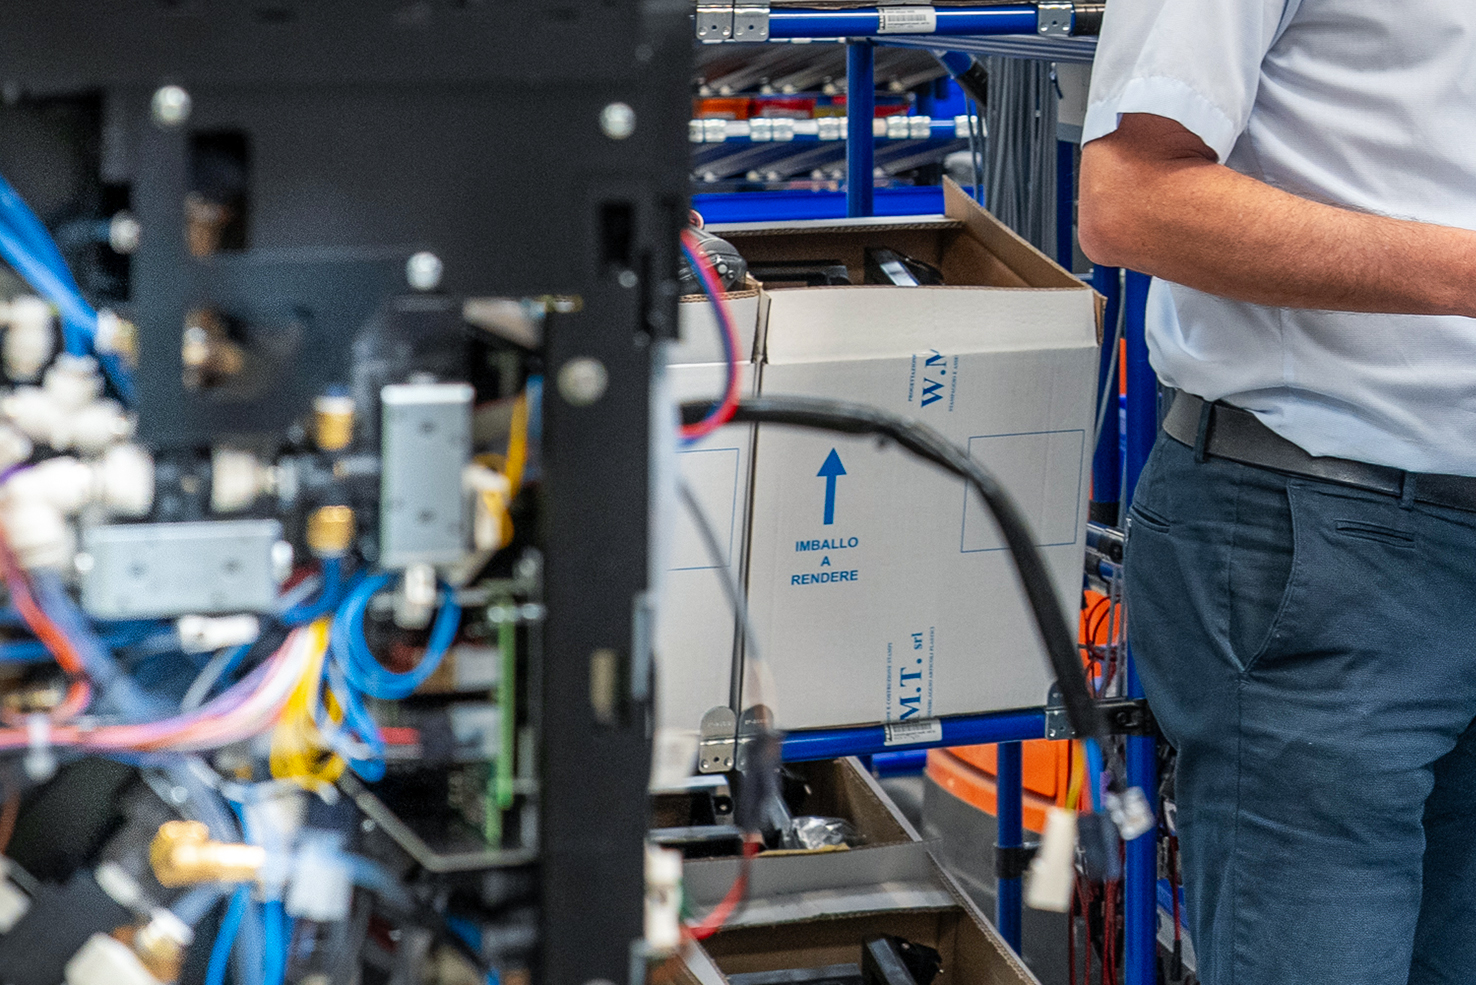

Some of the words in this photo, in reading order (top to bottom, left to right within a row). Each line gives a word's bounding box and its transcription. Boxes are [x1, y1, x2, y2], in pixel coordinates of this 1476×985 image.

[795, 536, 859, 553] IMBALLO
[820, 556, 831, 567] A
[790, 569, 859, 586] RENDERE
[899, 658, 922, 721] M.T.
[911, 632, 923, 650] srl
